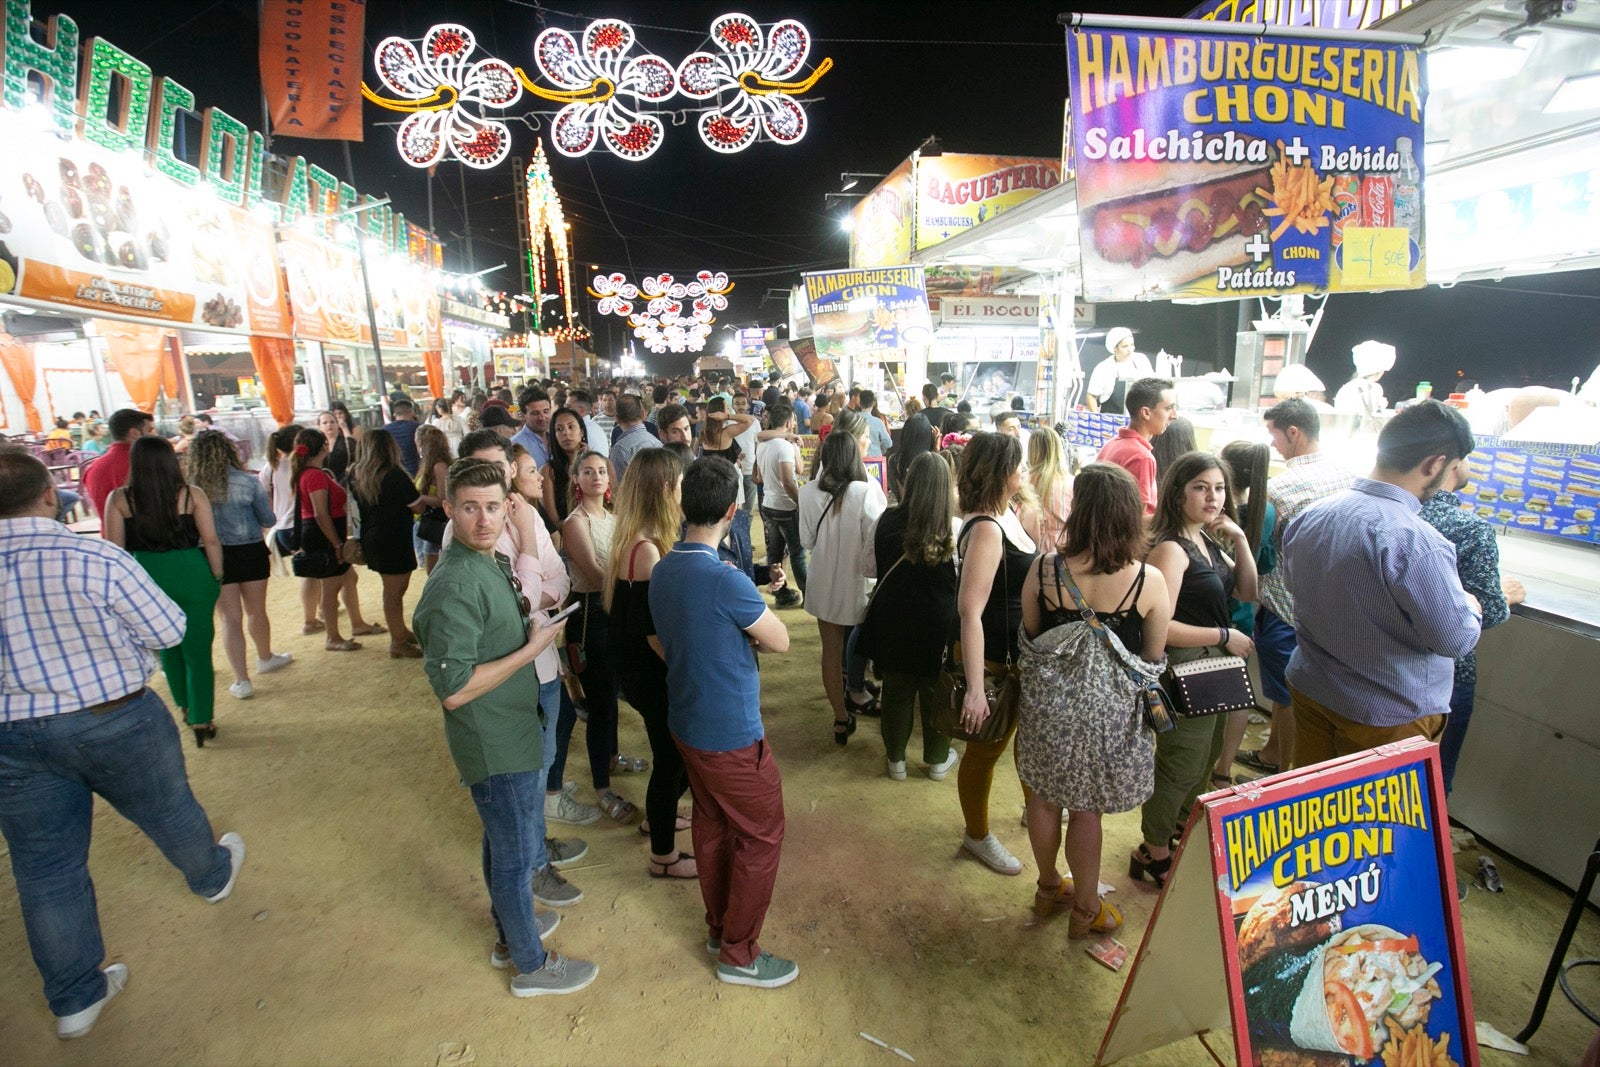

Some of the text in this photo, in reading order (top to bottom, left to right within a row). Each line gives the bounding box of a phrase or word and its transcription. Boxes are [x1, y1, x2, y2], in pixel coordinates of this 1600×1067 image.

[1077, 32, 1421, 124] HAMBURGUESERIA
[1183, 85, 1346, 129] CHONI
[1083, 127, 1268, 163] Salchicha
[1320, 145, 1400, 171] Bebida
[927, 165, 1060, 205] BAGUETERIA
[925, 216, 974, 227] HAMBURGUESA
[1283, 247, 1320, 260] CHONI
[806, 268, 922, 303] HAMBURGUESERIA
[842, 284, 898, 301] CHONI
[1217, 266, 1296, 290] Patatas
[953, 305, 975, 316] EL
[1225, 769, 1428, 892] HAMBURGUESERIA
[1272, 827, 1394, 888] CHONI
[1289, 862, 1382, 928] MENÚ
